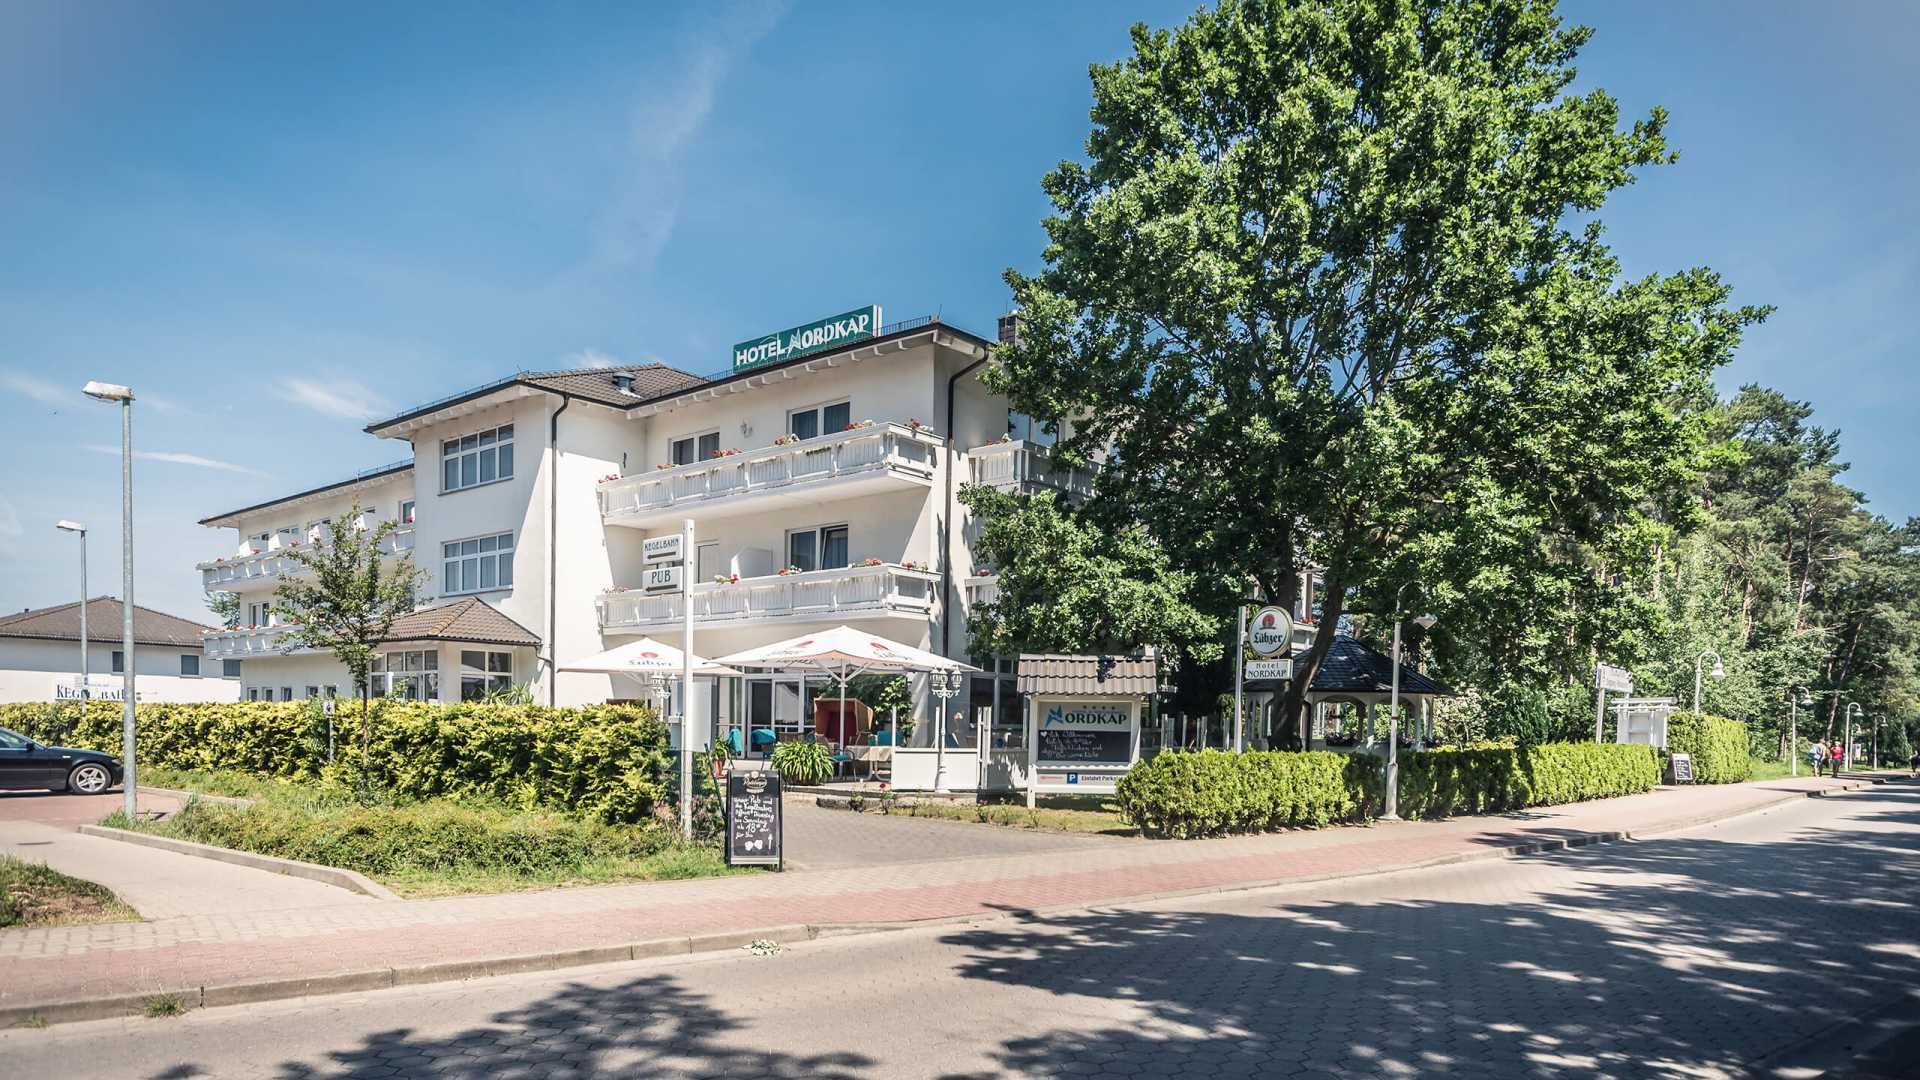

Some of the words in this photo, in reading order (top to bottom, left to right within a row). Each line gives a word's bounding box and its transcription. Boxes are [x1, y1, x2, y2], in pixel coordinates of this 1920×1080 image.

[736, 339, 785, 366] HOTEL
[784, 314, 869, 358] NORDKAP
[645, 539, 679, 551] KEGELBAHN
[652, 570, 671, 584] PUB
[1247, 670, 1287, 678] NORDKAP
